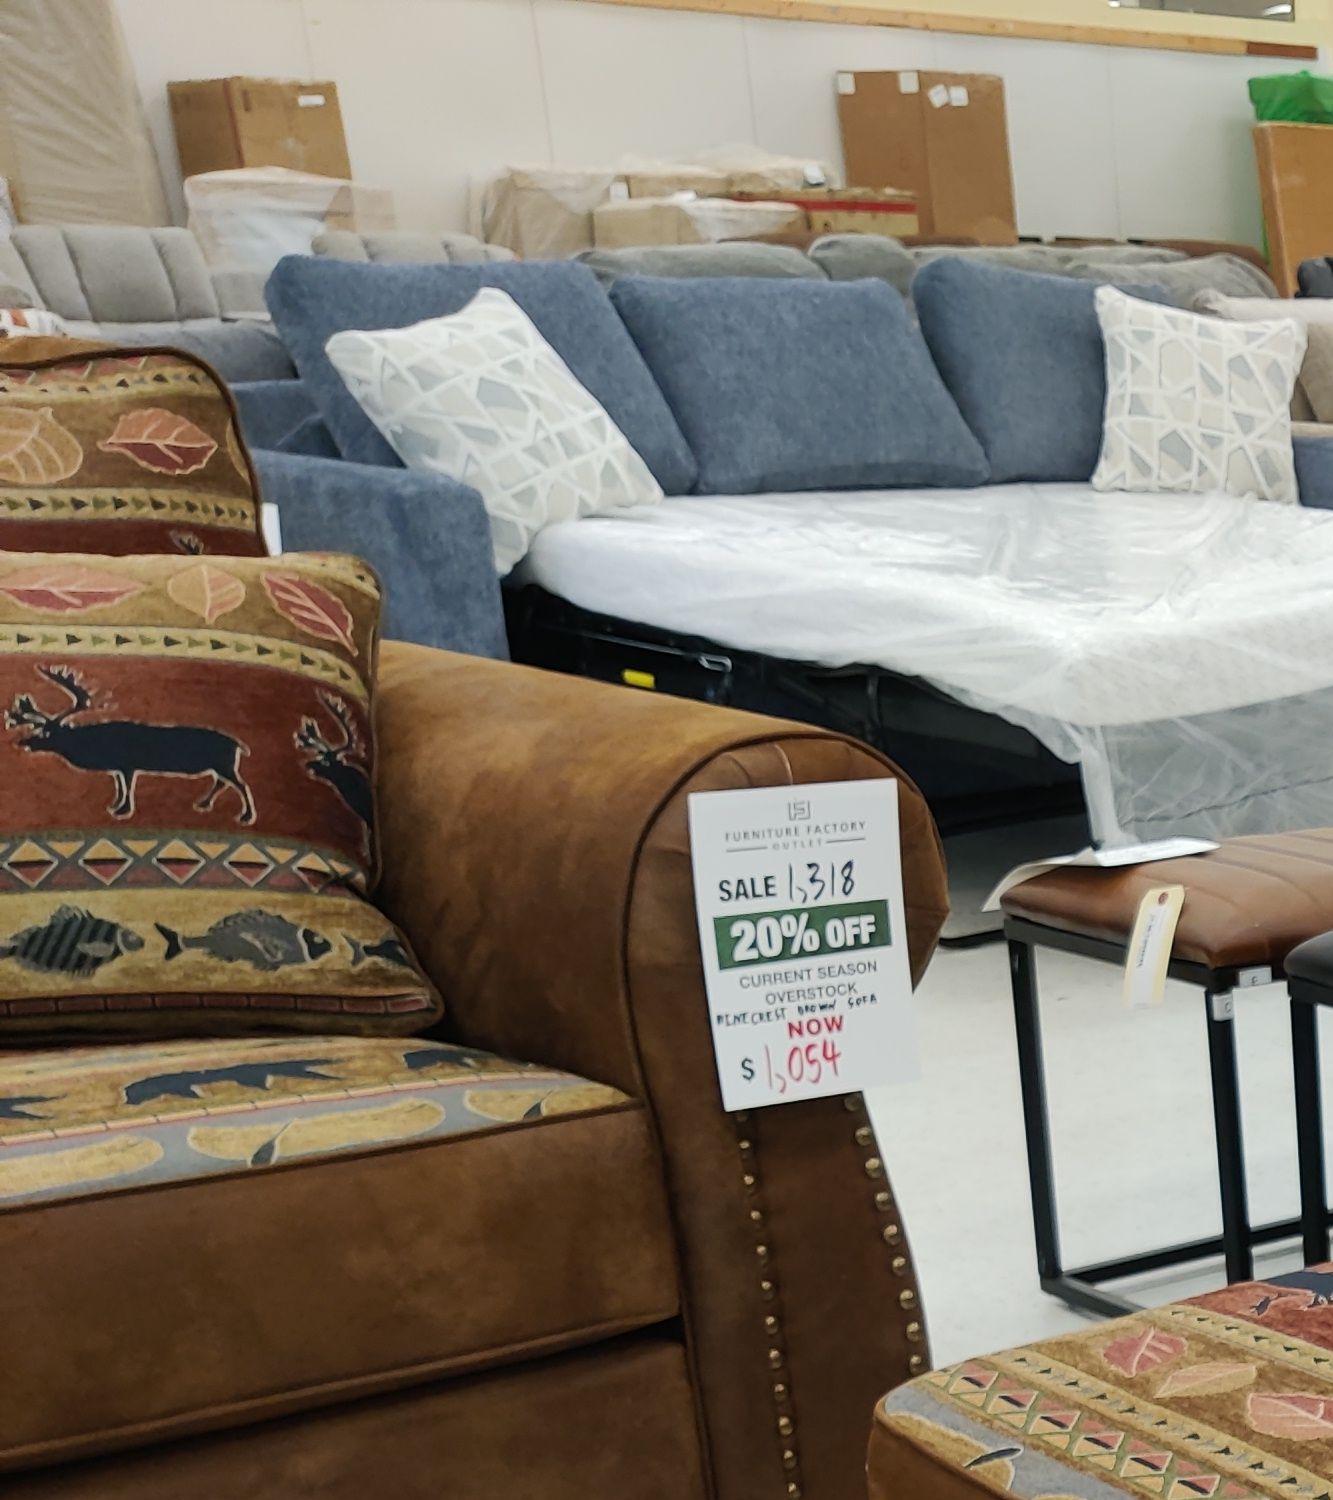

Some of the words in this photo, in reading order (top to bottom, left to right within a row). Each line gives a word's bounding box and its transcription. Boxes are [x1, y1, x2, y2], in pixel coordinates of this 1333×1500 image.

[725, 827, 800, 842] FURNITURE
[807, 821, 867, 836] FACTORY
[772, 838, 823, 850] OUTLET
[719, 875, 776, 901] SALE
[788, 859, 855, 903] 1,318
[730, 912, 820, 962] 20%
[826, 914, 876, 949] OFF
[740, 969, 812, 989] CURRENT
[818, 960, 877, 979] SEASON
[765, 982, 858, 1004] OVERSTOCK
[788, 1015, 844, 1038] NOW
[741, 1058, 755, 1081] $
[764, 1040, 841, 1094] 1,054
